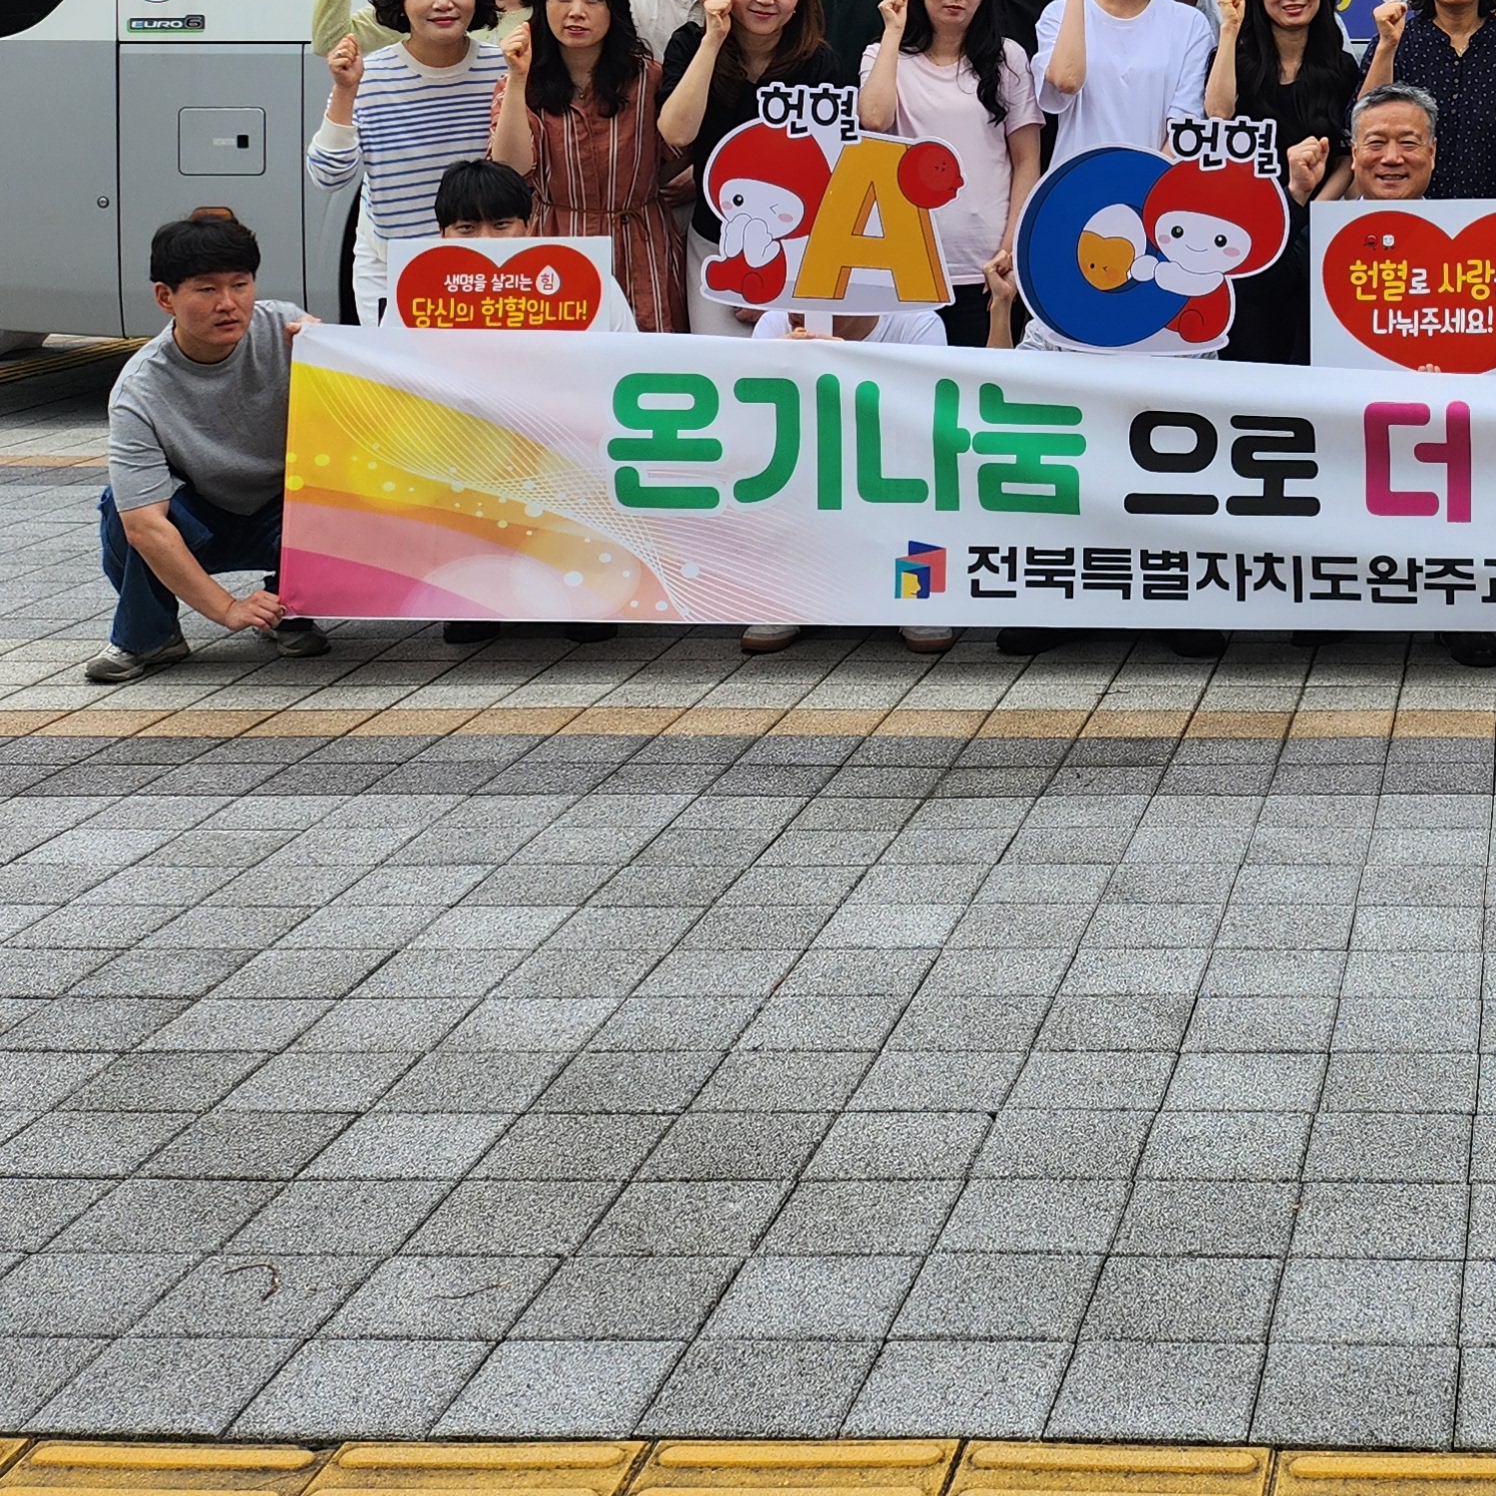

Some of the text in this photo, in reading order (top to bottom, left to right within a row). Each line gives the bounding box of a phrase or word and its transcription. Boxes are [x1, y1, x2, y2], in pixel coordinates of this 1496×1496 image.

[760, 86, 858, 141] 헌혈
[1170, 117, 1277, 175] 헌혈
[443, 272, 555, 292] 생명을 살리는 힘
[1349, 259, 1431, 302] 헌혈로
[412, 296, 588, 328] 당신의 헌혈입니다!
[1371, 305, 1494, 337] 나눠주세요!
[606, 372, 1087, 516] 온기나눔
[1124, 410, 1321, 518] 으로
[1363, 400, 1472, 524] 더
